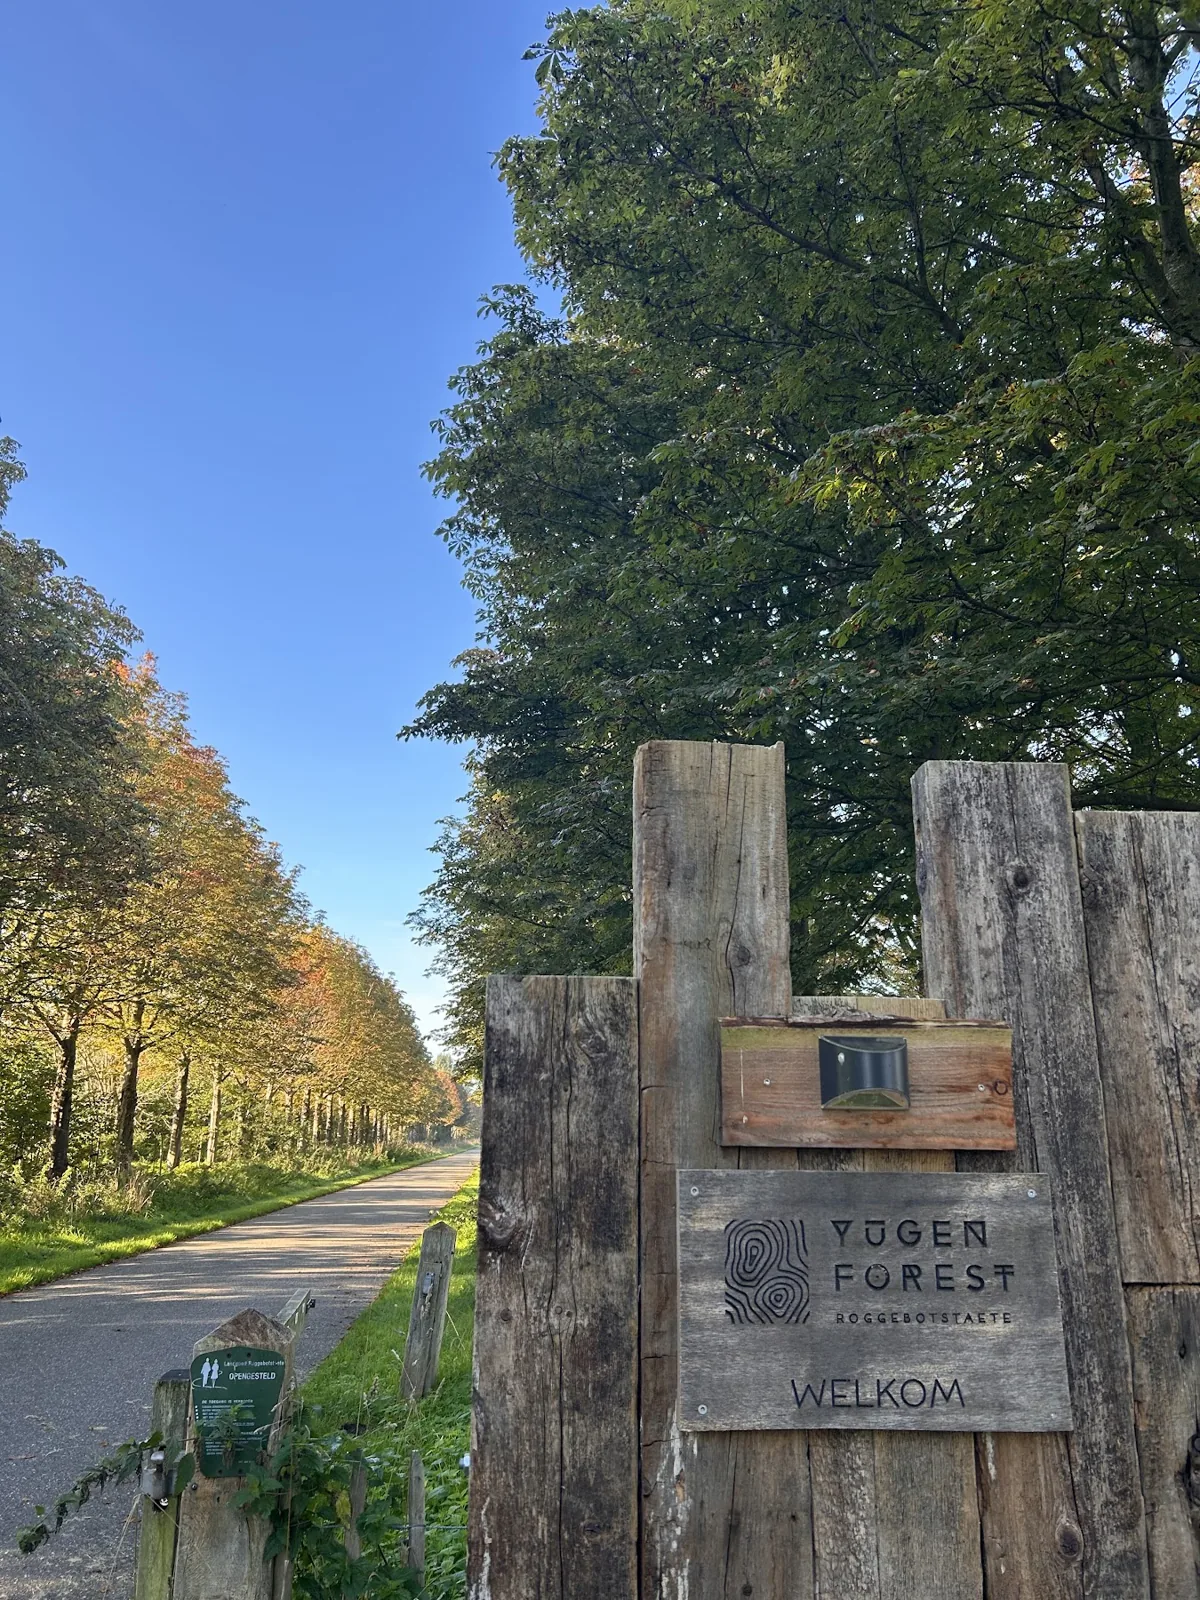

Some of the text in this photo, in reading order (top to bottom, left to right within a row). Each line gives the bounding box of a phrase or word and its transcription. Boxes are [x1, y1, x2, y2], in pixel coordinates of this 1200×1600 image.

[834, 1263, 1015, 1292] FOREST
[836, 1312, 1012, 1324] ROGGEBOTSTAETE
[229, 1372, 276, 1380] OPENGESTELD
[790, 1378, 966, 1409] WELKOM
